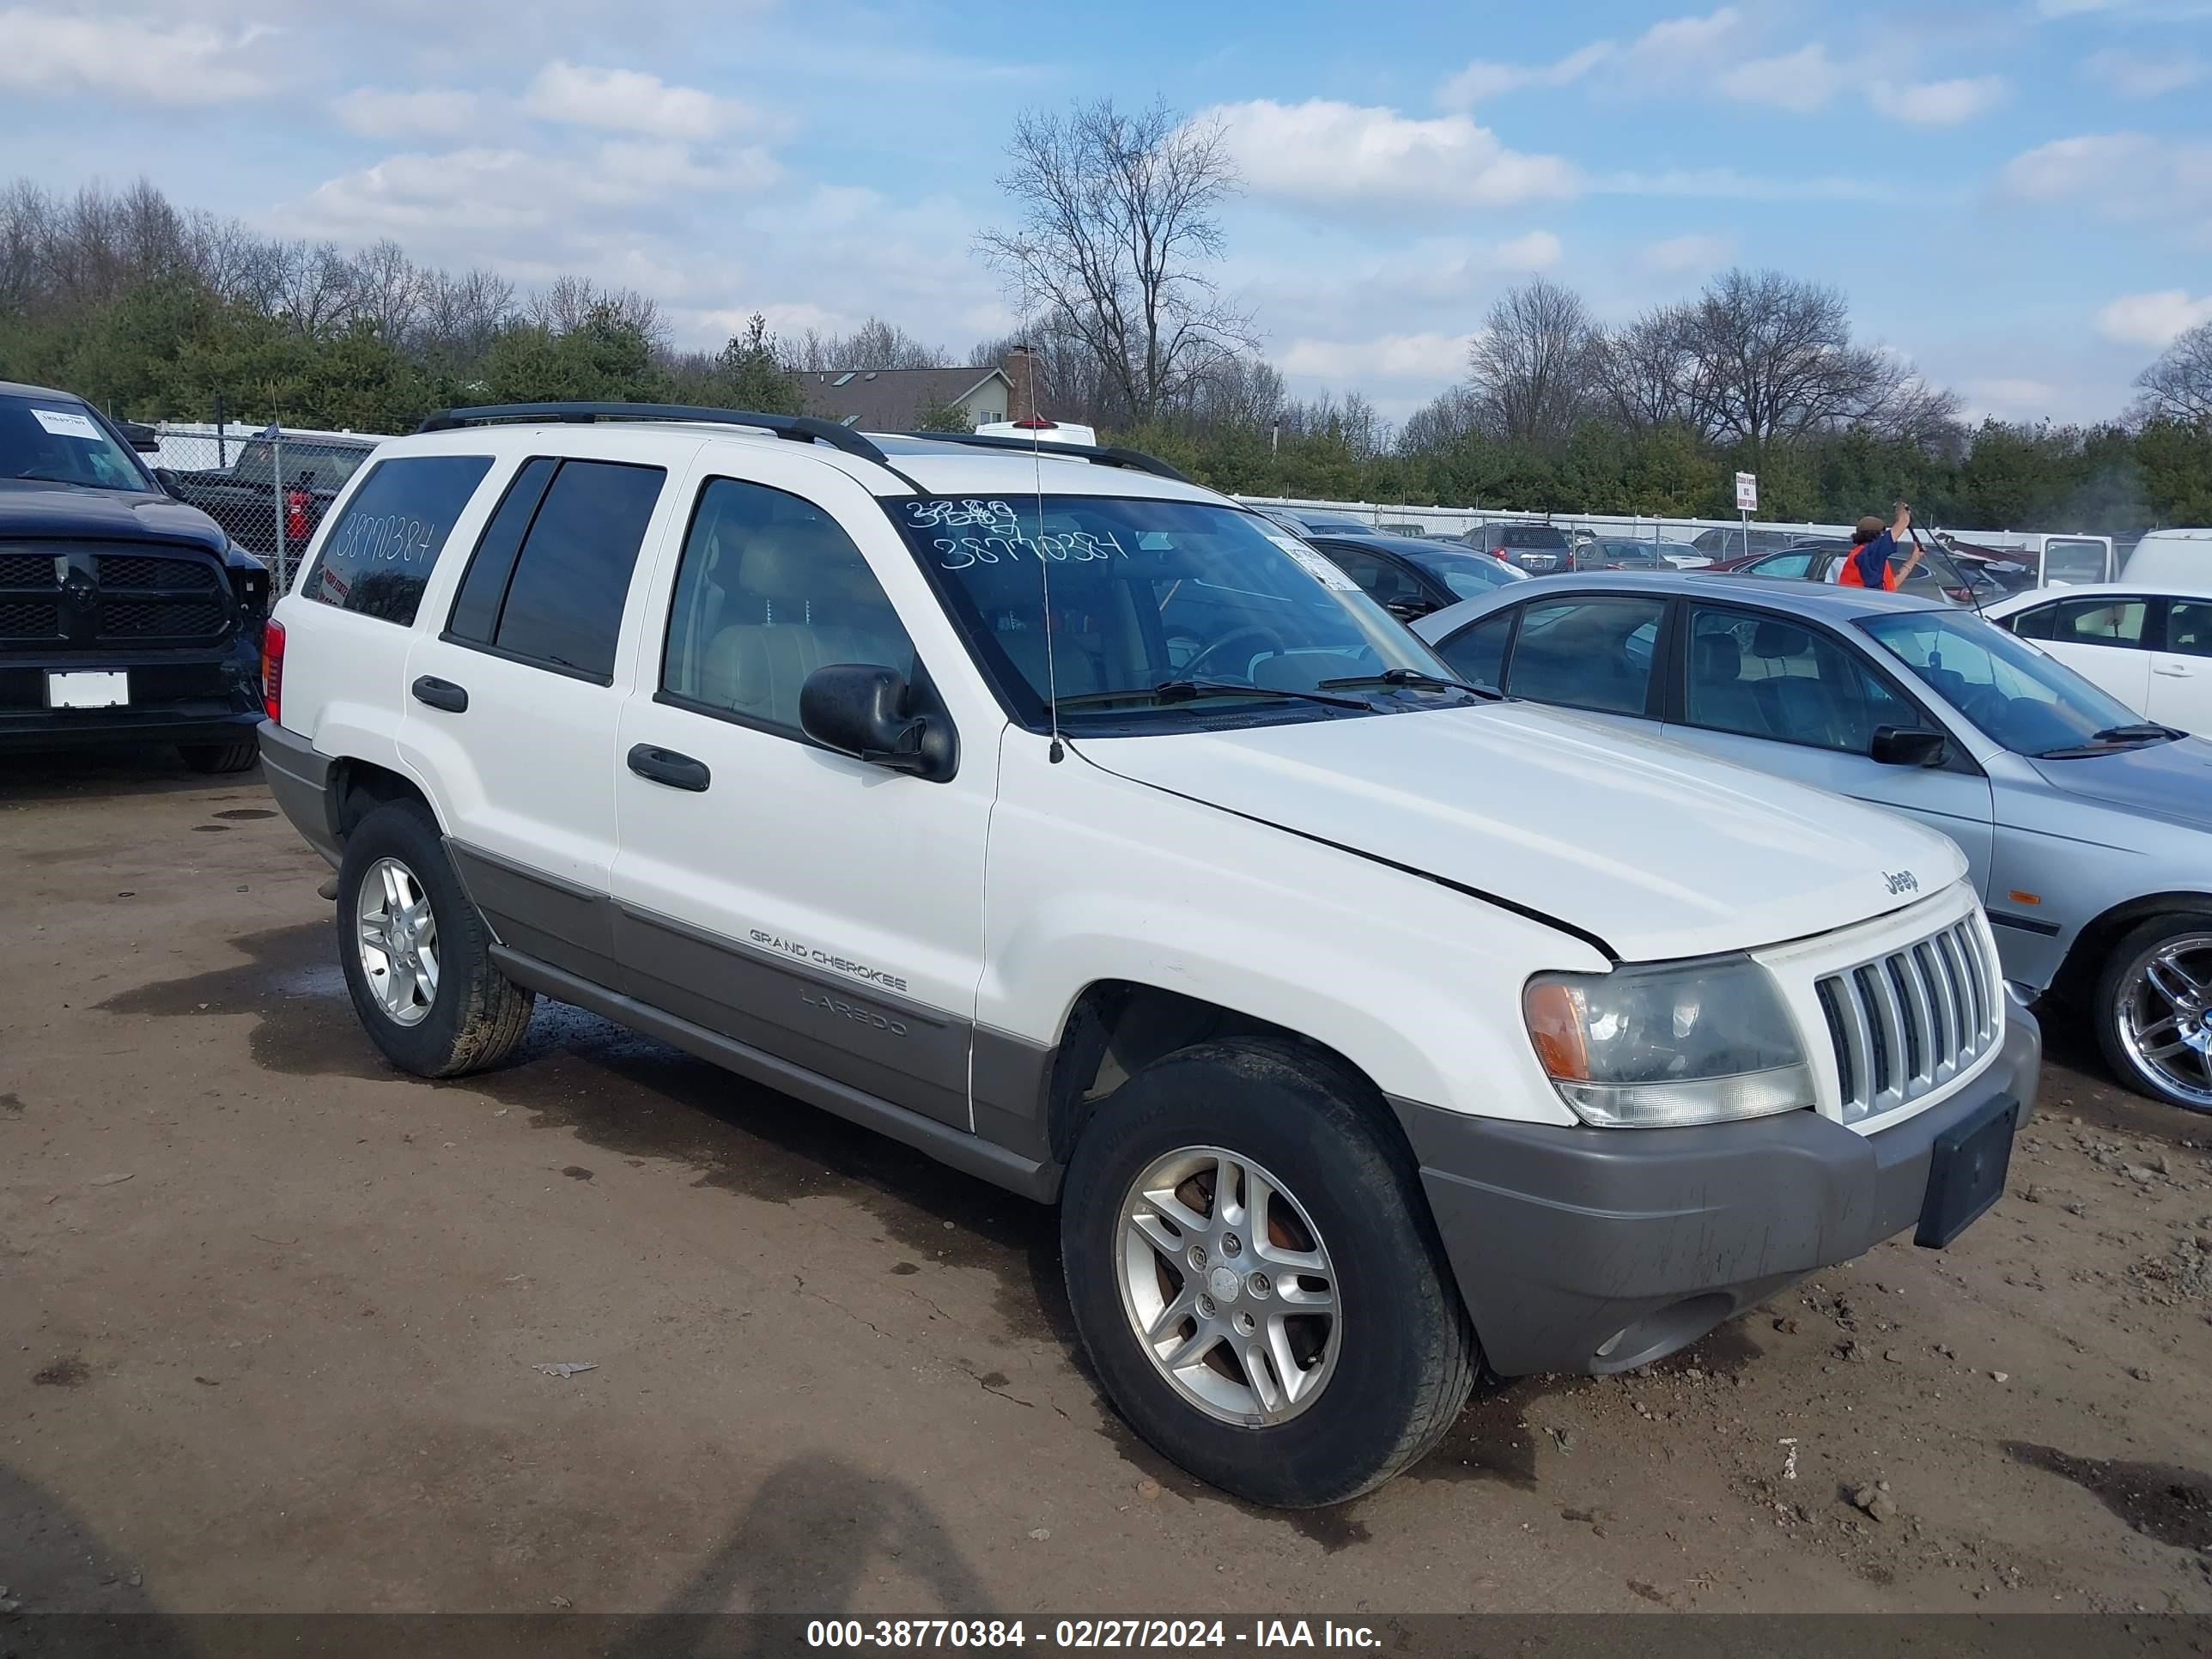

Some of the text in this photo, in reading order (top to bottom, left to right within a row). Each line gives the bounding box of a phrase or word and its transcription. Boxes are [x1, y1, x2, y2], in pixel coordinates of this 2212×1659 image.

[337, 513, 434, 563] 38770384
[933, 531, 1128, 569] 38770384
[1881, 870, 1919, 895] Jeep
[749, 928, 908, 992] GRAND CHEROKEE
[799, 988, 908, 1037] LAREDO
